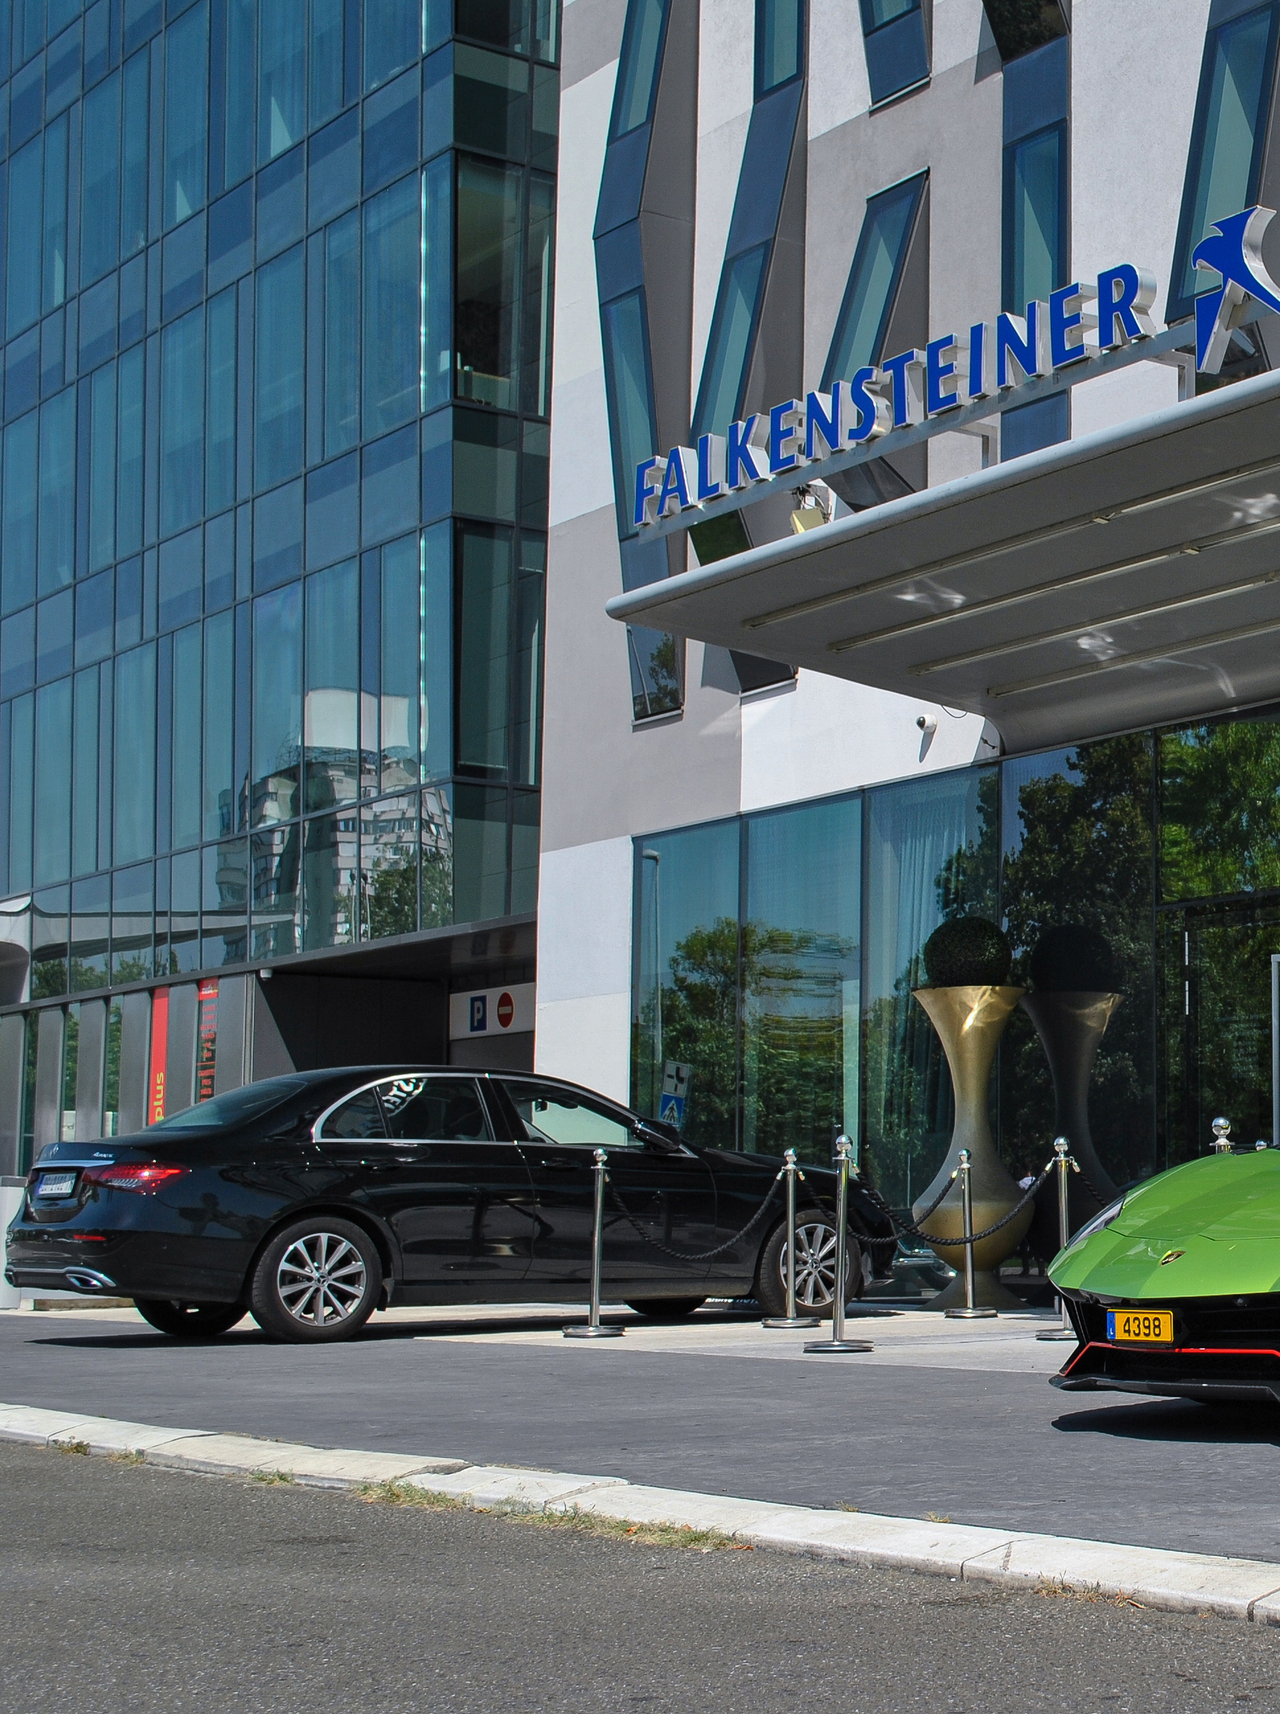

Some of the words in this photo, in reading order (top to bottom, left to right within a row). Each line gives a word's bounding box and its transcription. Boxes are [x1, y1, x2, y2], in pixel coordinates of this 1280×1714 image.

[634, 263, 1148, 526] FALKENSTEINER
[474, 1000, 483, 1027] P
[153, 1071, 165, 1122] plus
[1123, 1316, 1161, 1337] 4398
